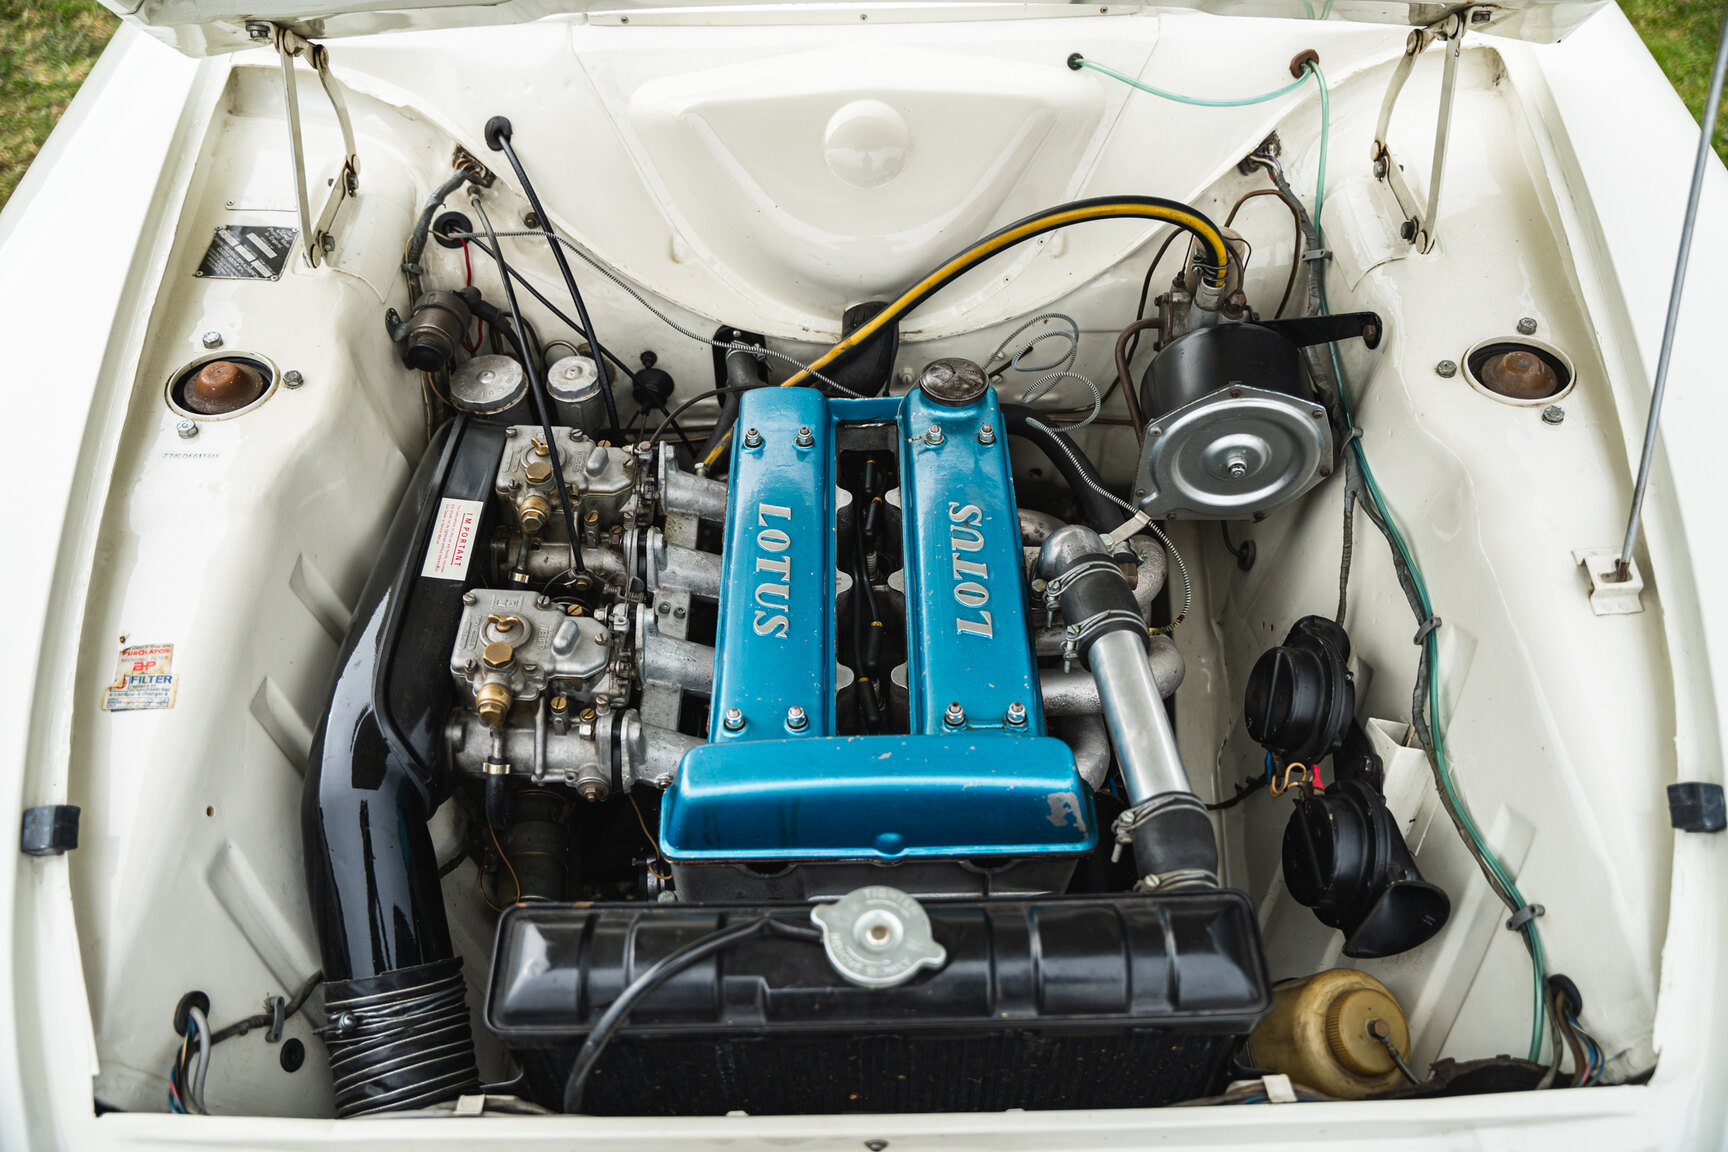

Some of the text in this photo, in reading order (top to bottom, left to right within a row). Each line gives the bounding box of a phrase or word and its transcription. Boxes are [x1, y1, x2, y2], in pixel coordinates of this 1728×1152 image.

[454, 513, 473, 566] IMPORTANT
[753, 502, 793, 640] LOTUS
[948, 501, 994, 640] LOTUS
[130, 675, 172, 684] FILTER
